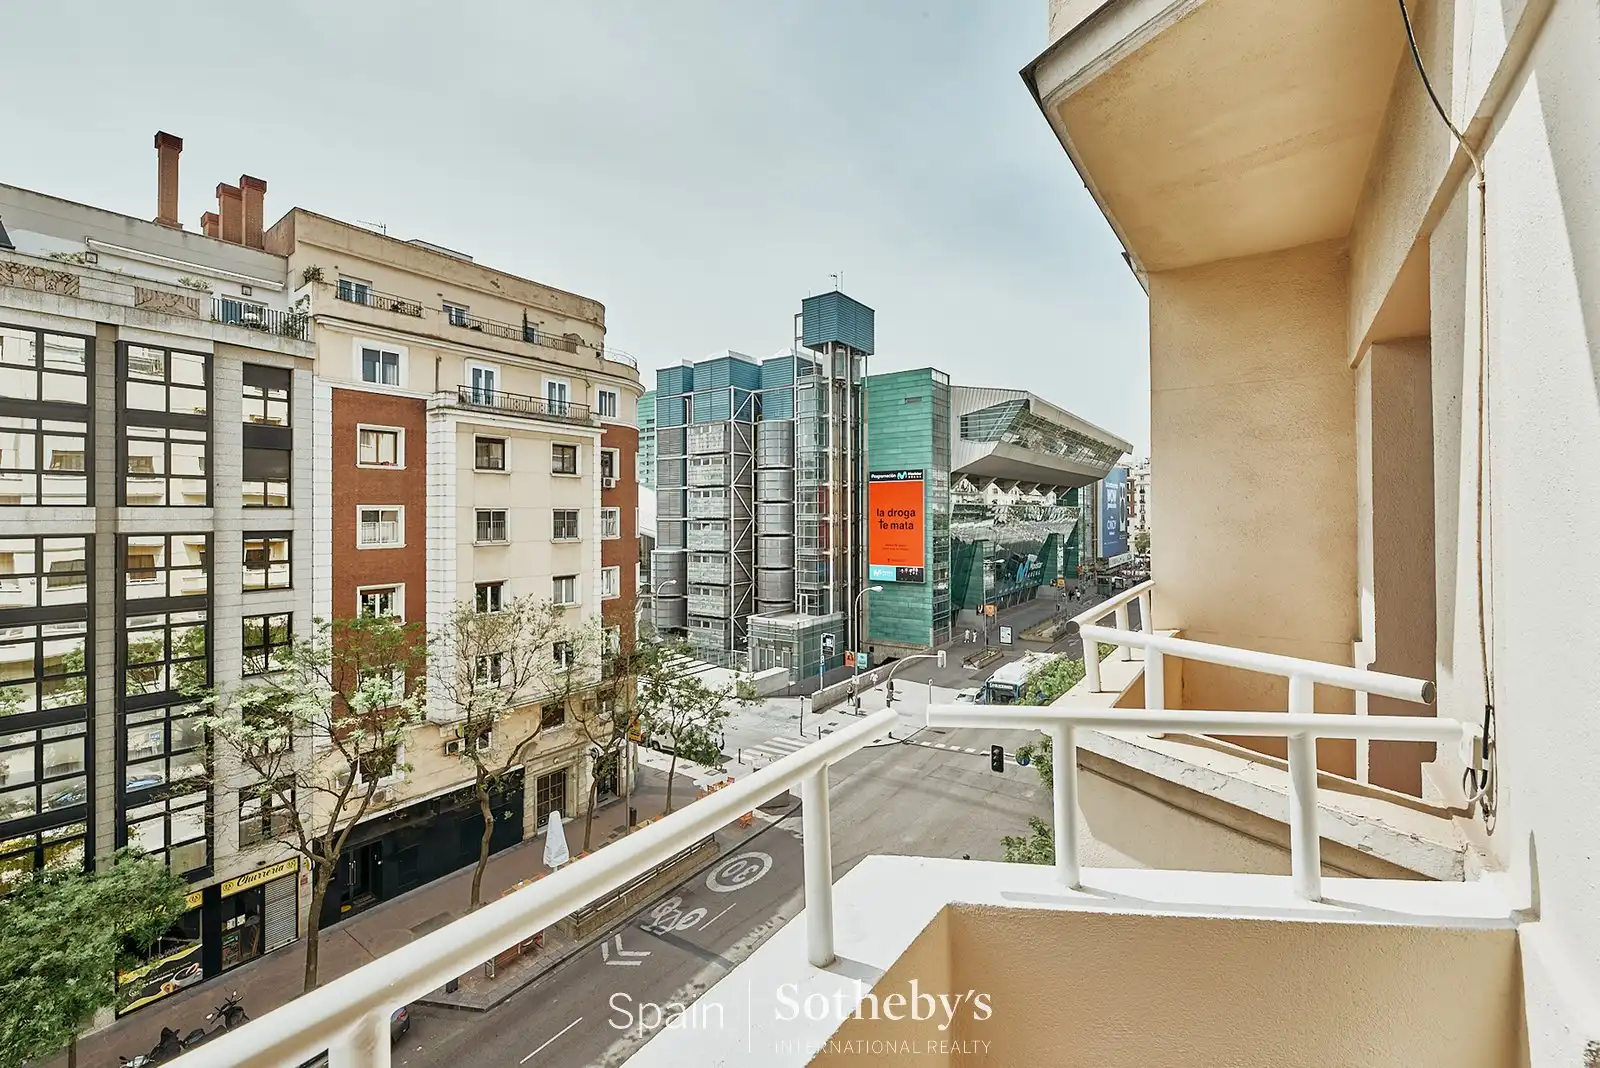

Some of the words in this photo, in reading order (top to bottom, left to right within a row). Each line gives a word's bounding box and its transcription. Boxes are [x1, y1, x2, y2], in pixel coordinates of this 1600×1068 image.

[877, 508, 885, 517] la
[887, 508, 916, 519] droga
[879, 518, 889, 530] te
[890, 520, 914, 530] mata
[722, 860, 760, 883] 30
